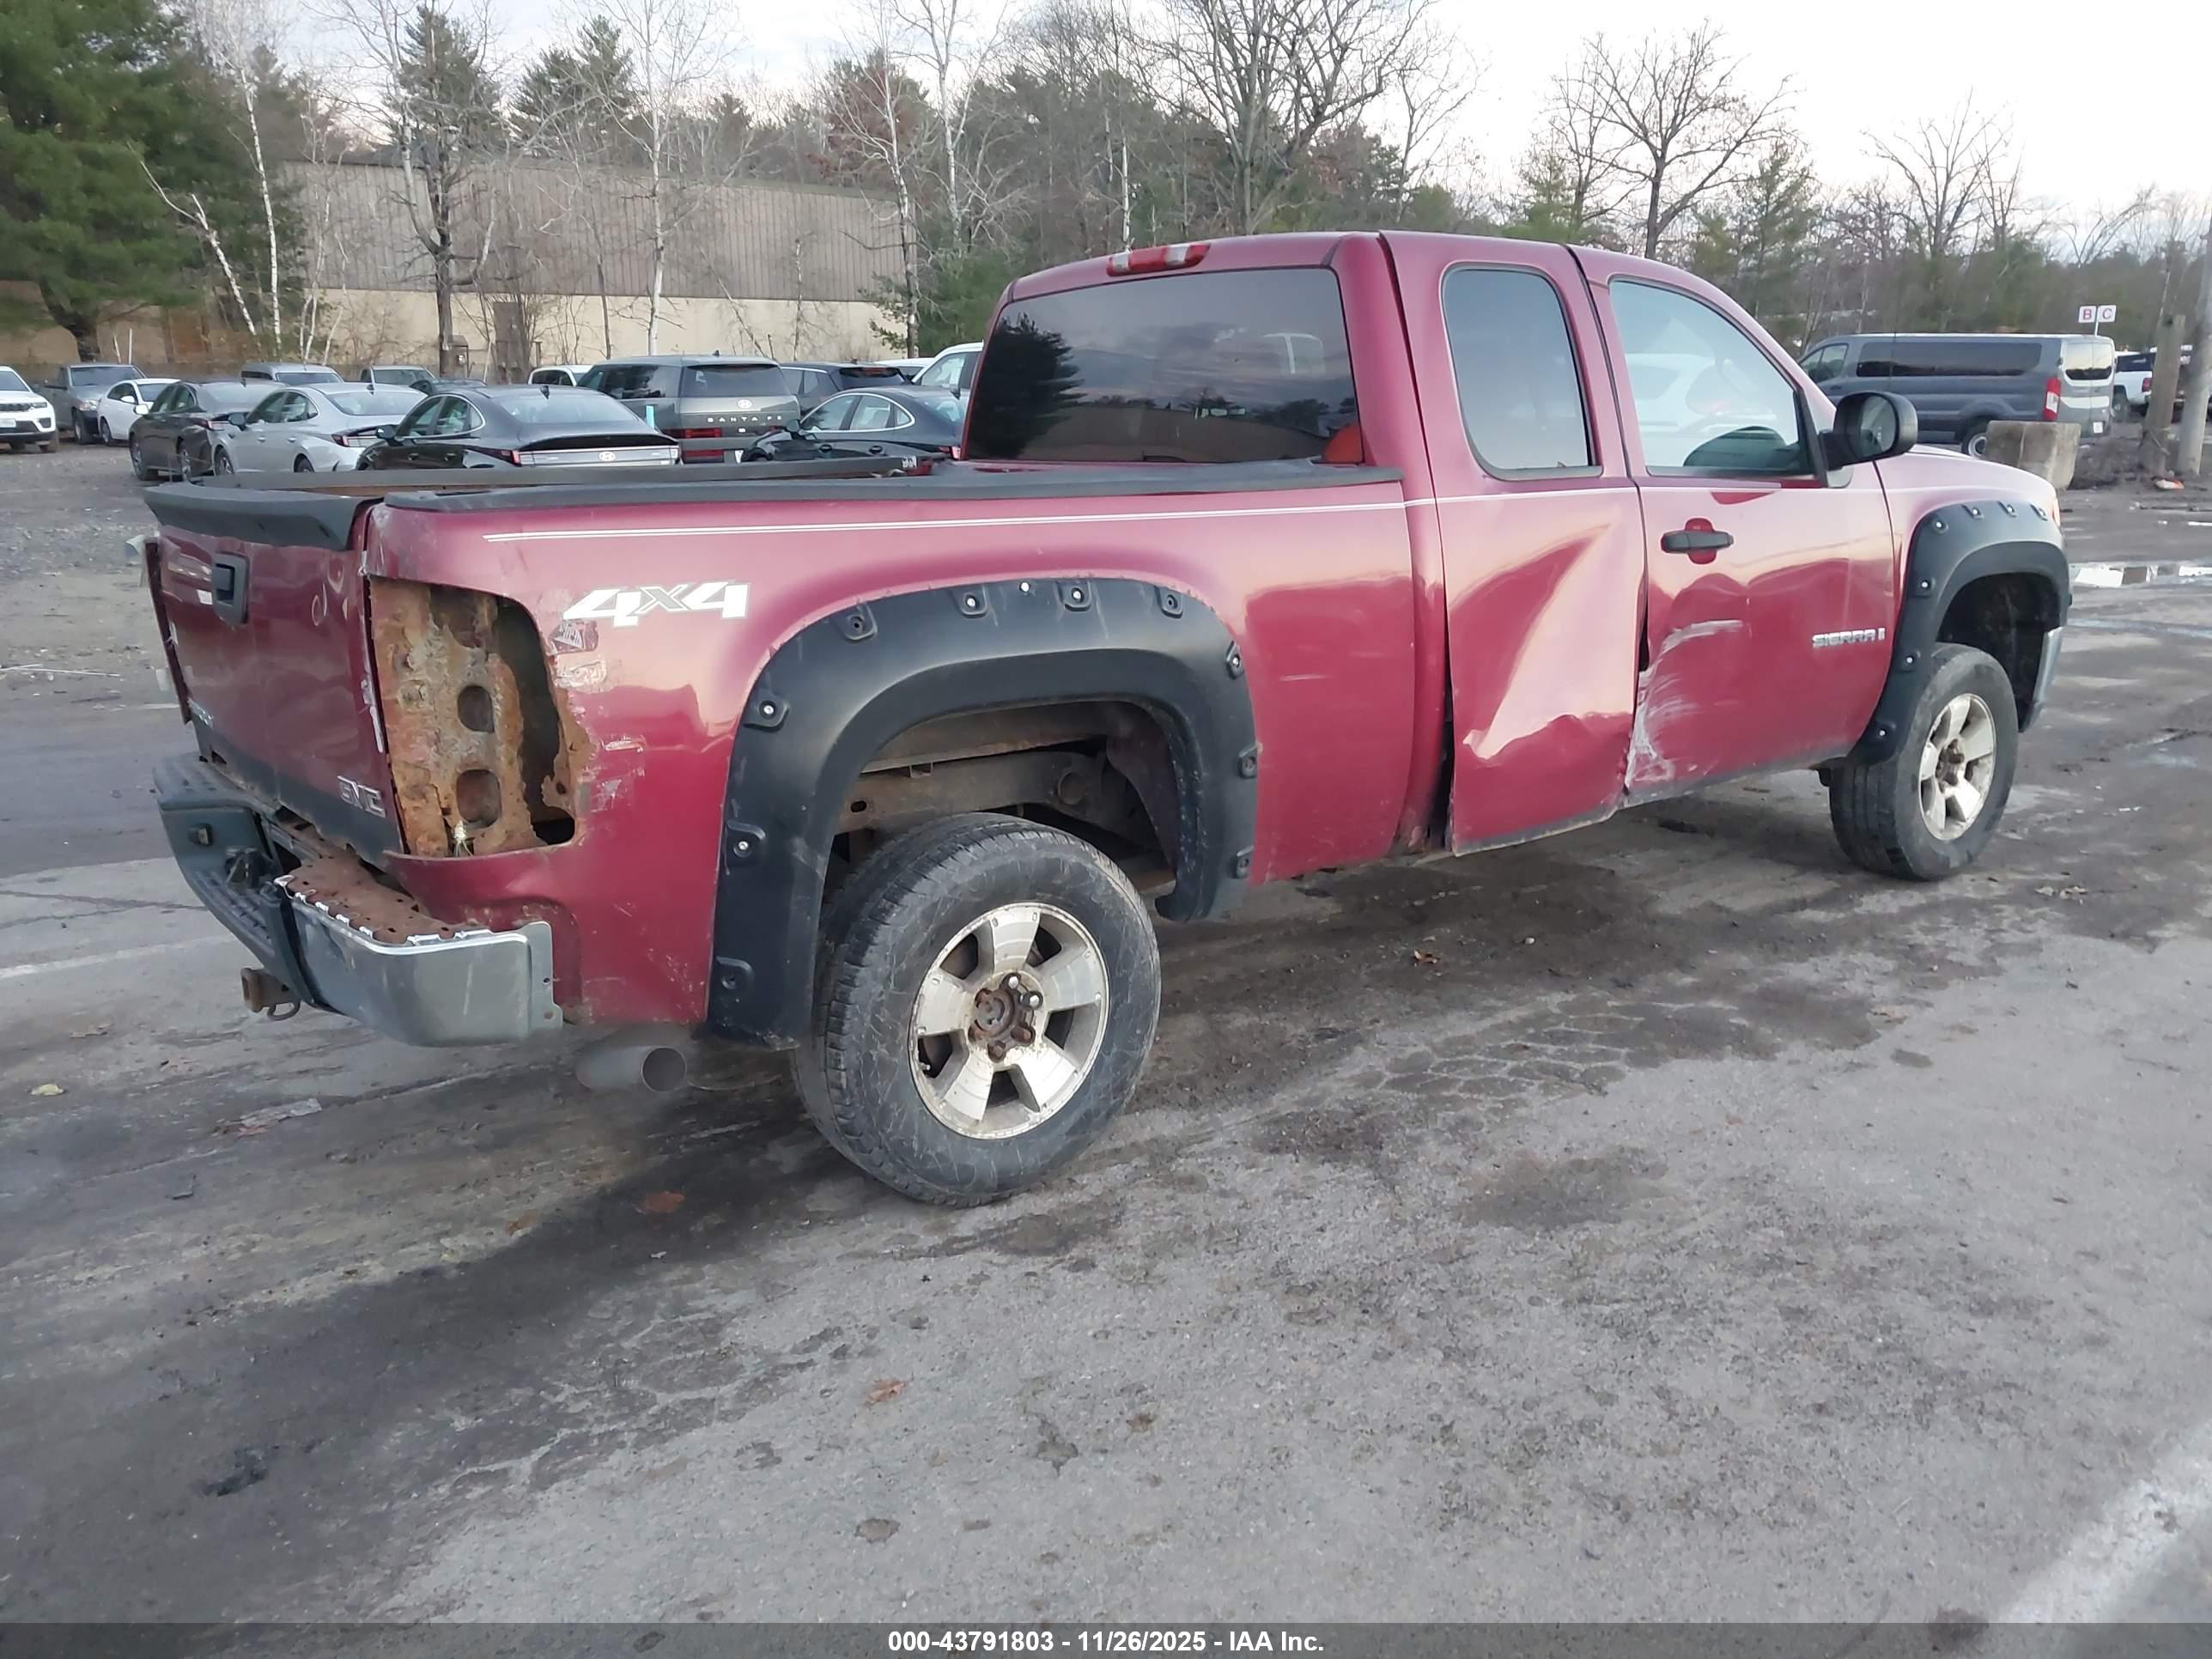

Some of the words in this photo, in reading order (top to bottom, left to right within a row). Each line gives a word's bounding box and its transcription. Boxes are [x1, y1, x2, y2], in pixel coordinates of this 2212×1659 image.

[2083, 308, 2093, 320] B
[2102, 307, 2113, 319] C
[1812, 629, 1876, 647] SIERRA
